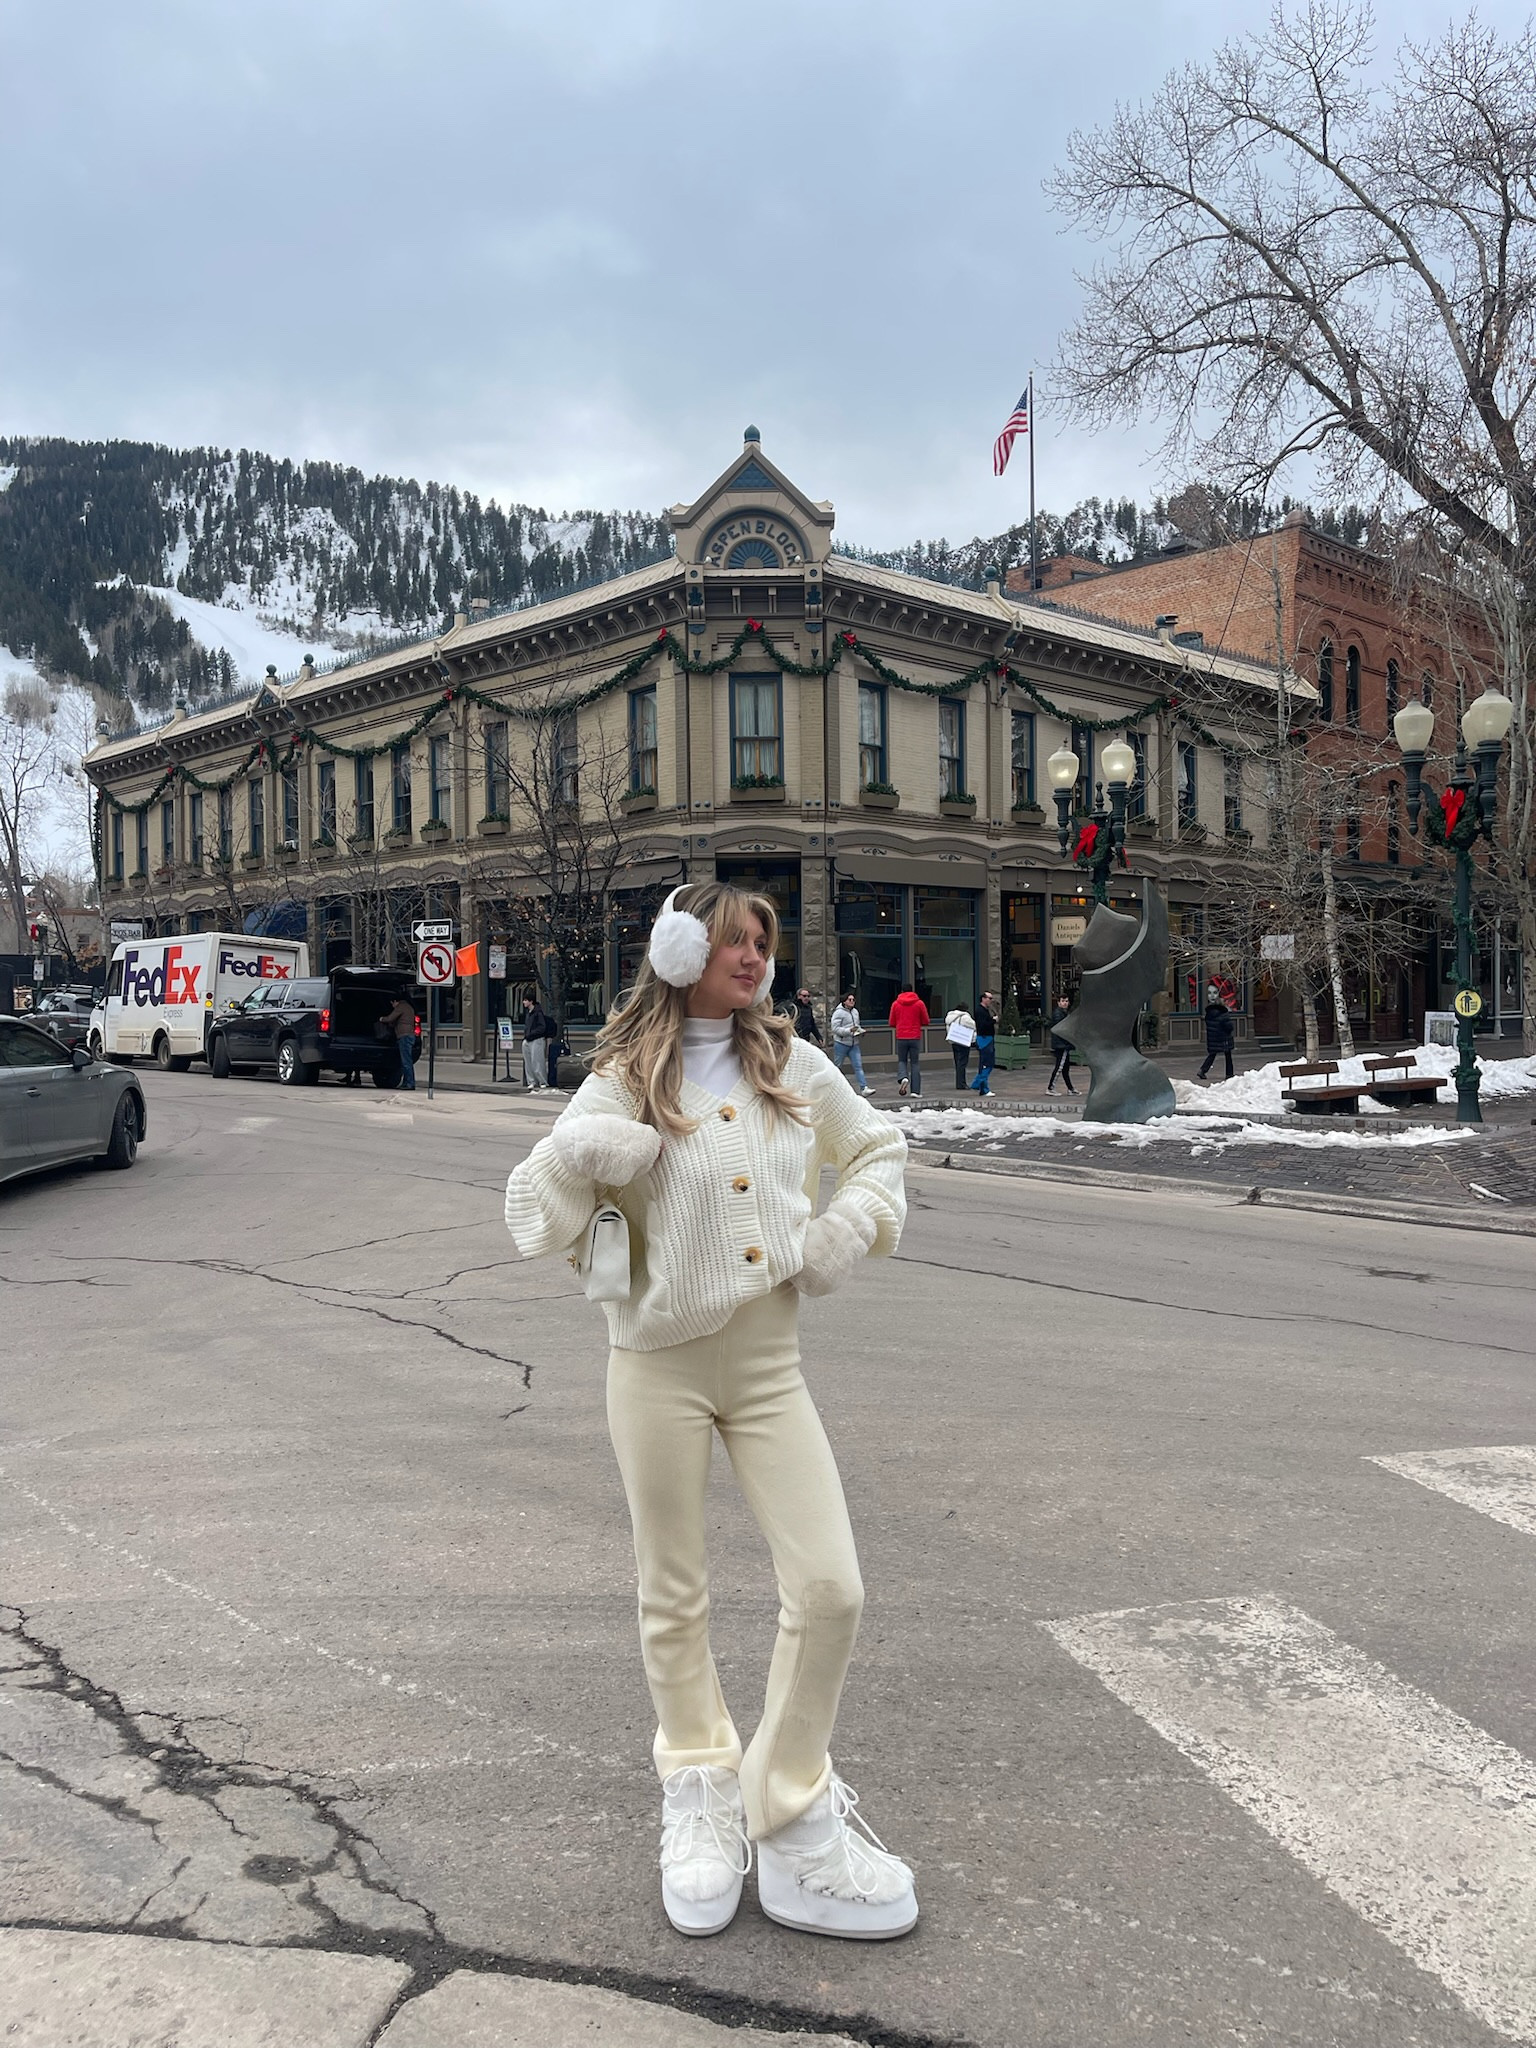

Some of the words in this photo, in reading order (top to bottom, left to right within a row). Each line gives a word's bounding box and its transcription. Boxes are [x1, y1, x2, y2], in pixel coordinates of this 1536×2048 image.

[710, 520, 751, 567] ASPEN
[755, 519, 800, 567] BLOCK
[128, 929, 141, 937] BAR
[423, 926, 435, 935] ONE
[436, 926, 447, 935] WAY
[219, 952, 291, 979] FedEx
[122, 946, 201, 1007] FedEx
[163, 1006, 183, 1019] Express
